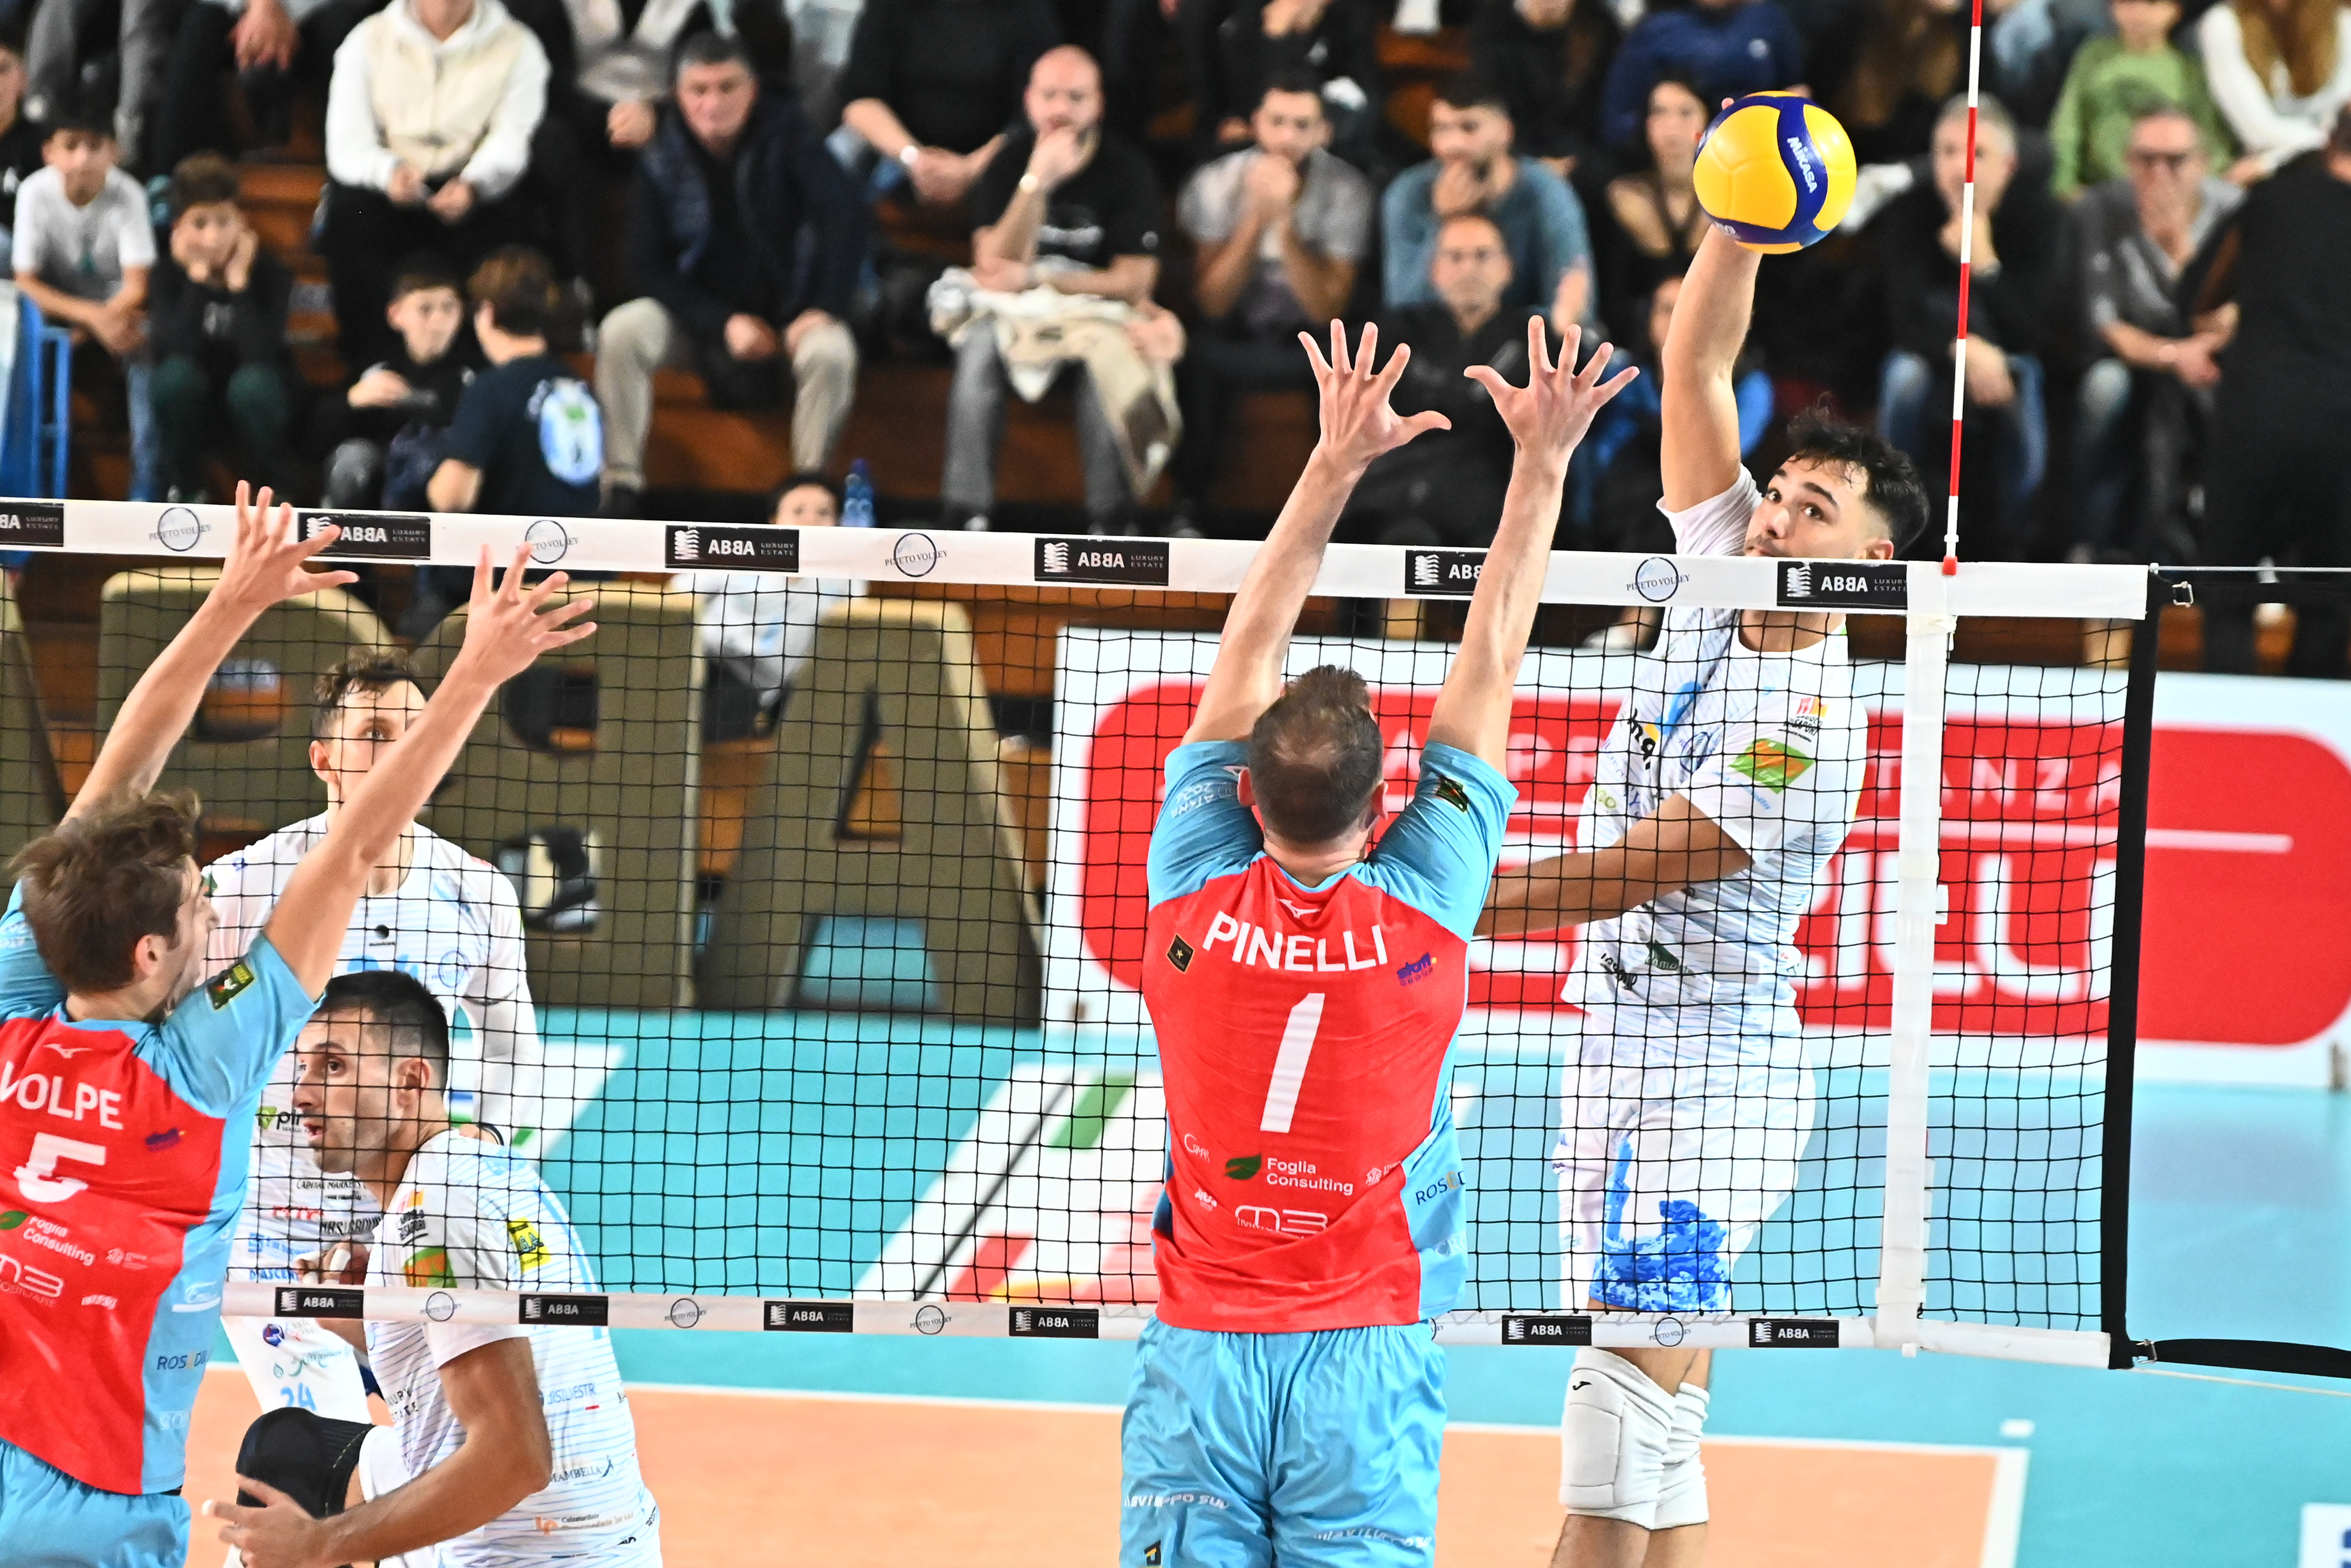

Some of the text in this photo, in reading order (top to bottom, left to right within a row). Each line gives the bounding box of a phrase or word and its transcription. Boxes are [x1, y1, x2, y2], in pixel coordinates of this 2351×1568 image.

[708, 540, 755, 556] ABBA
[1078, 552, 1125, 568] ABBA
[1820, 576, 1868, 592] ABBA
[1203, 910, 1388, 973] PINELLI
[1260, 993, 1325, 1133] 1
[0, 1060, 124, 1130] VOLPE
[13, 1132, 106, 1203] 5
[1267, 1157, 1316, 1175] Foglia
[1266, 1173, 1354, 1196] Consulting
[23, 1227, 95, 1266] Consulting
[303, 1296, 334, 1308] ABBA
[793, 1311, 824, 1321] ABBA
[1037, 1317, 1069, 1328] ABBA
[1530, 1325, 1562, 1335] ABBA
[1778, 1328, 1810, 1339] ABBA
[281, 1382, 316, 1411] 24
